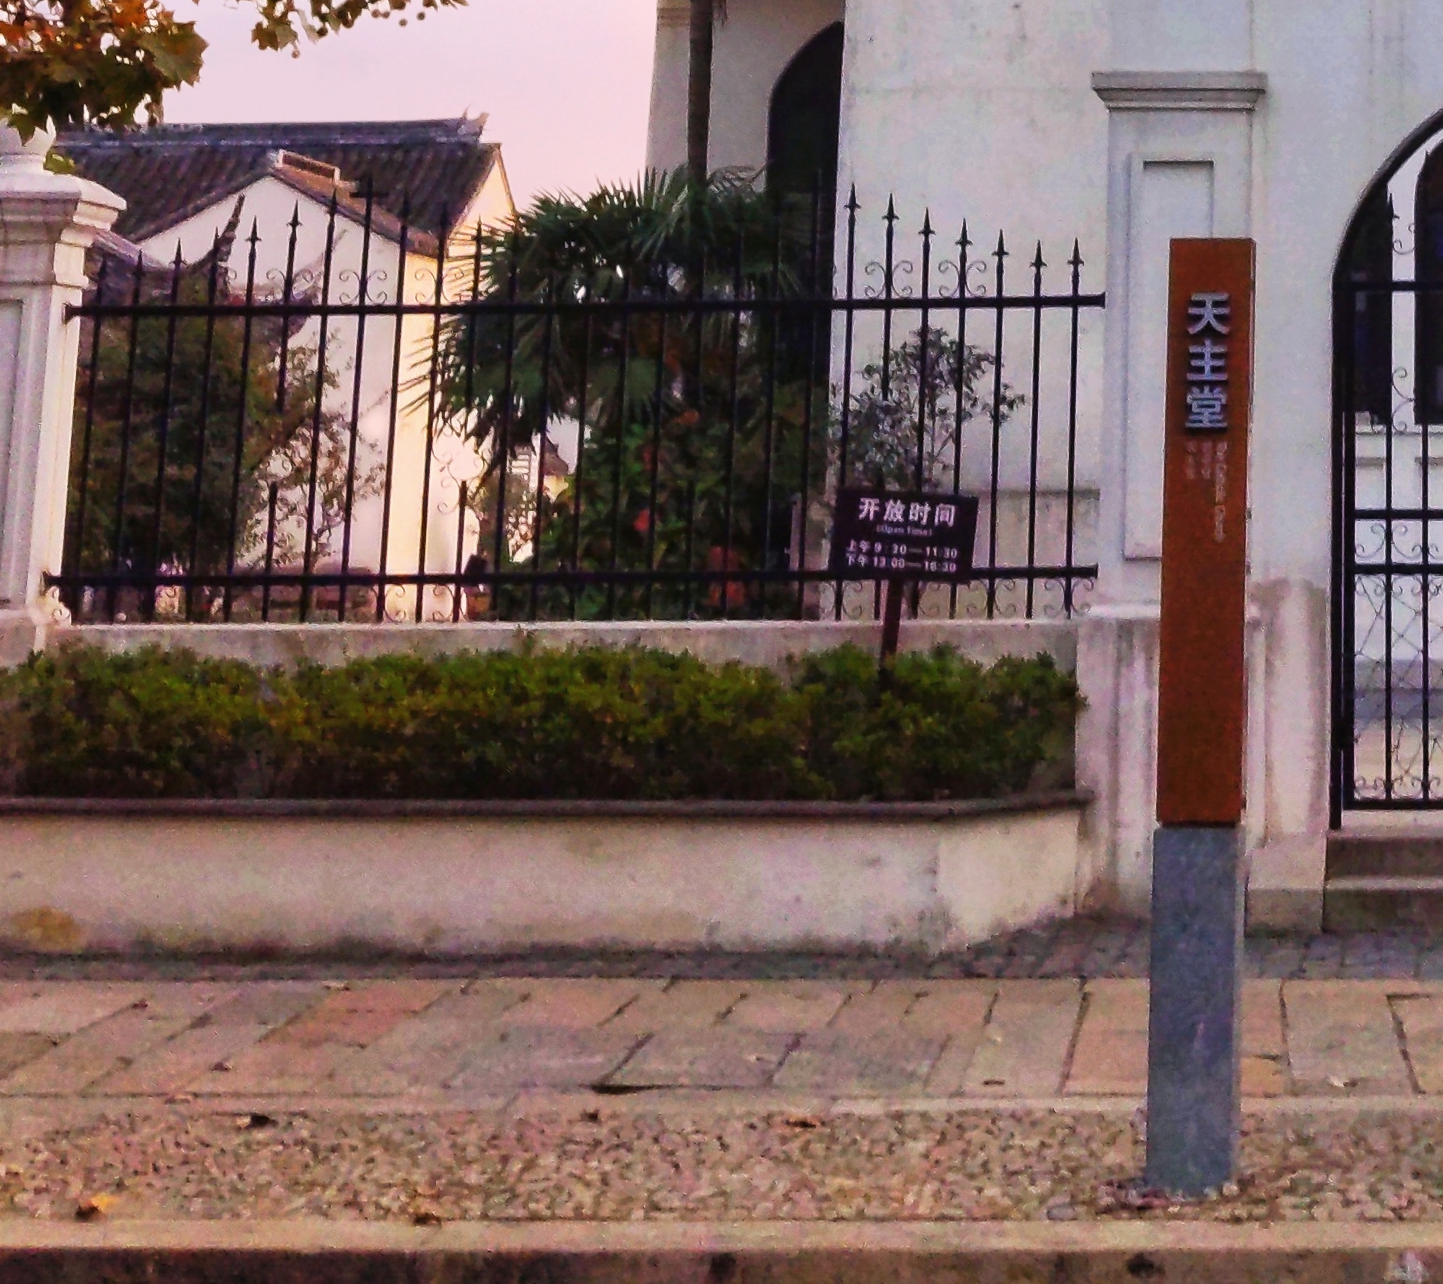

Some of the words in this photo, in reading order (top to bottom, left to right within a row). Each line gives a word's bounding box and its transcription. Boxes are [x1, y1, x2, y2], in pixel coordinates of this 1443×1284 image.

[1185, 292, 1230, 429] 天主堂
[859, 497, 957, 528] 开放时间
